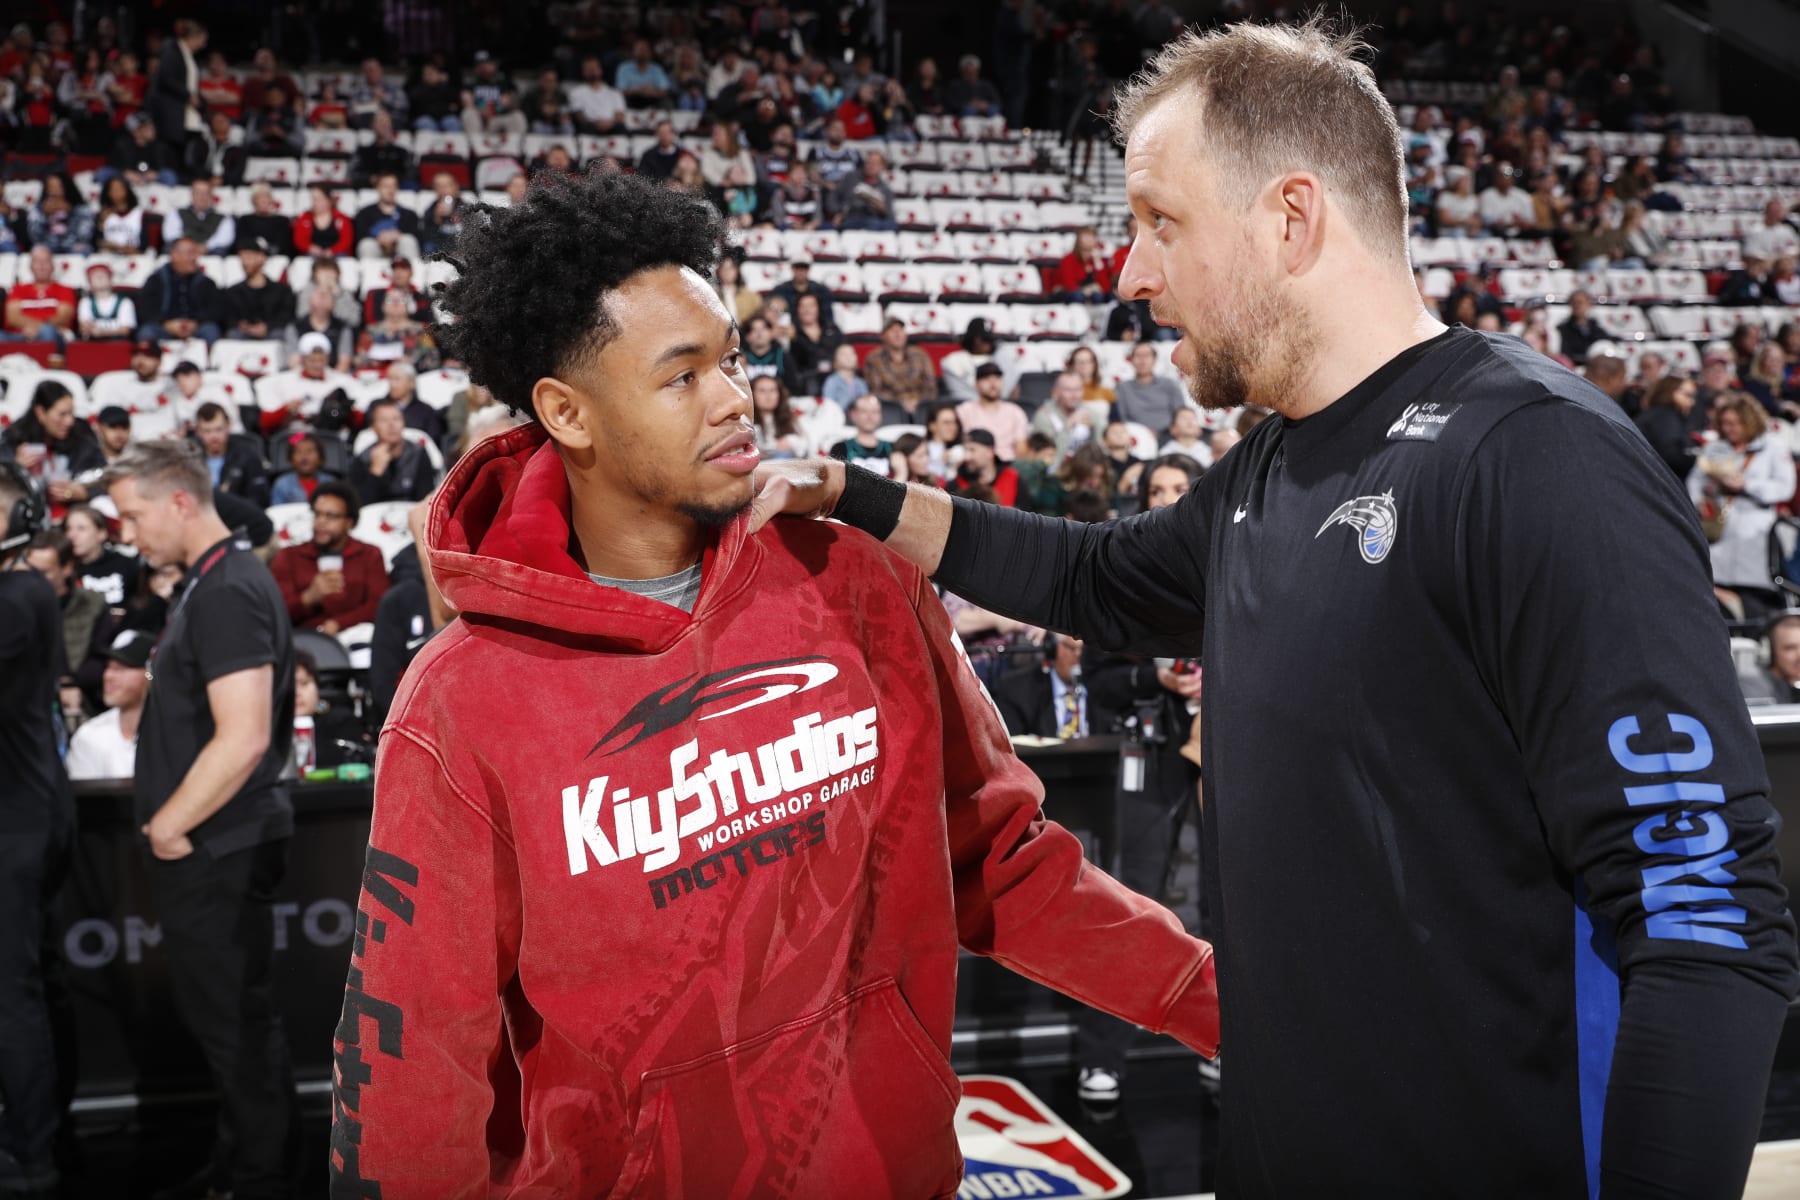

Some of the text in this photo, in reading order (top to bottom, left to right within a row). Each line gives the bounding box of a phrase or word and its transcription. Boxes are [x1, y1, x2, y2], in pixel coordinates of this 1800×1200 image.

[1412, 412, 1450, 424] National
[562, 706, 878, 876] KiyStudios
[697, 765, 875, 852] WORKSHOP GARAGE
[956, 1168, 1056, 1200] NBA
